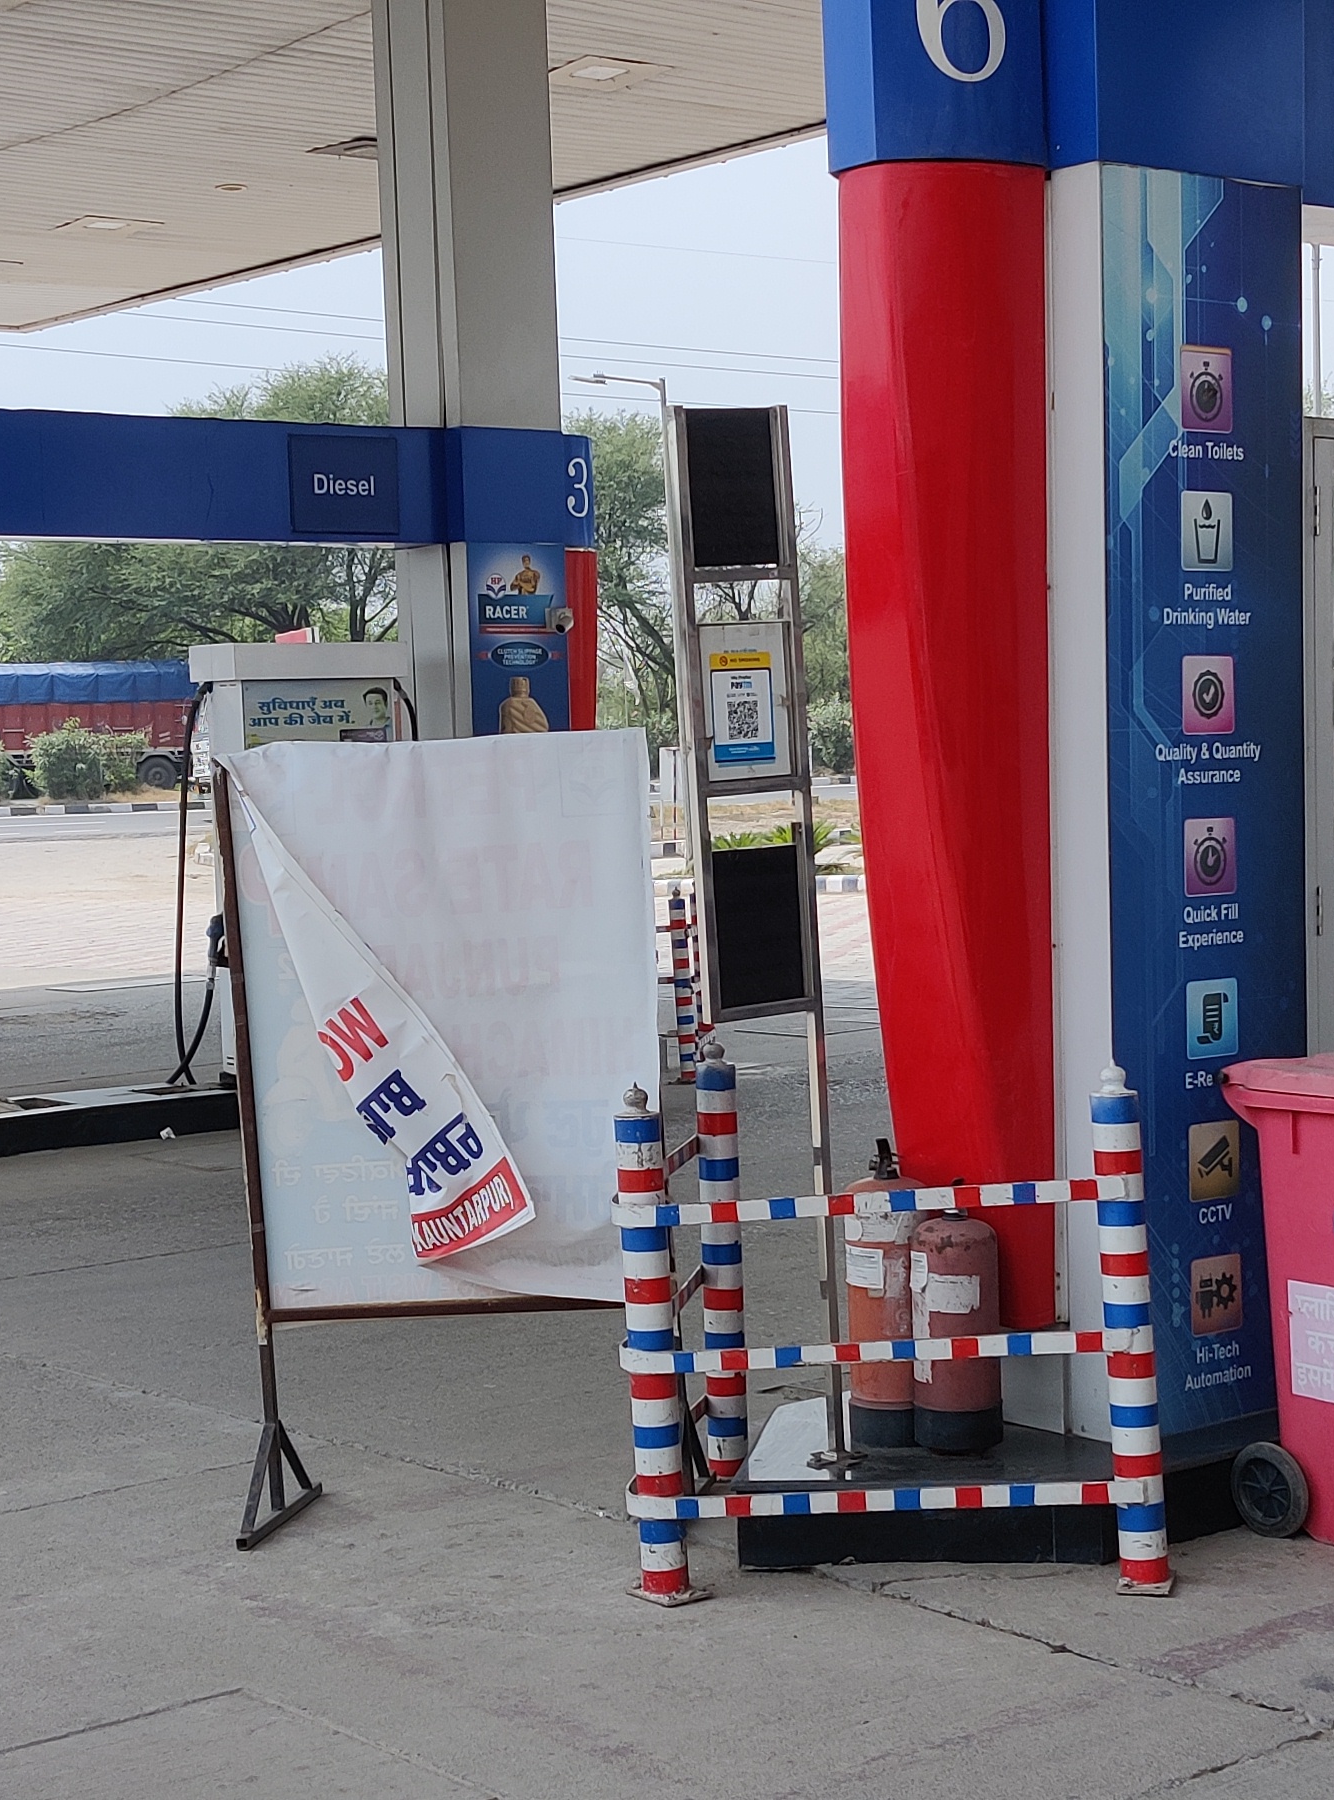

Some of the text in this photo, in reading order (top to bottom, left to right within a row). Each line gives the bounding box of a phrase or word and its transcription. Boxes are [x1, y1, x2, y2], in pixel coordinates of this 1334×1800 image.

[917, 0, 1005, 81] 6
[1169, 441, 1244, 461] Clean Toilets
[313, 473, 376, 498] Diesel
[567, 457, 589, 517] 3
[491, 577, 503, 585] HP
[1184, 583, 1232, 602] Purified
[485, 605, 528, 619] RACER
[1163, 607, 1251, 629] Drinking Water
[249, 716, 280, 727] आप
[283, 712, 304, 726] की
[1155, 742, 1261, 766] Quality & Quantity
[1178, 767, 1241, 785] Assurance
[1183, 903, 1239, 924] Quick Fill
[1178, 927, 1244, 949] Experience
[1198, 1203, 1233, 1224] CCTV
[1196, 1342, 1240, 1364] Hi-Tech
[1185, 1364, 1251, 1391] Automation
